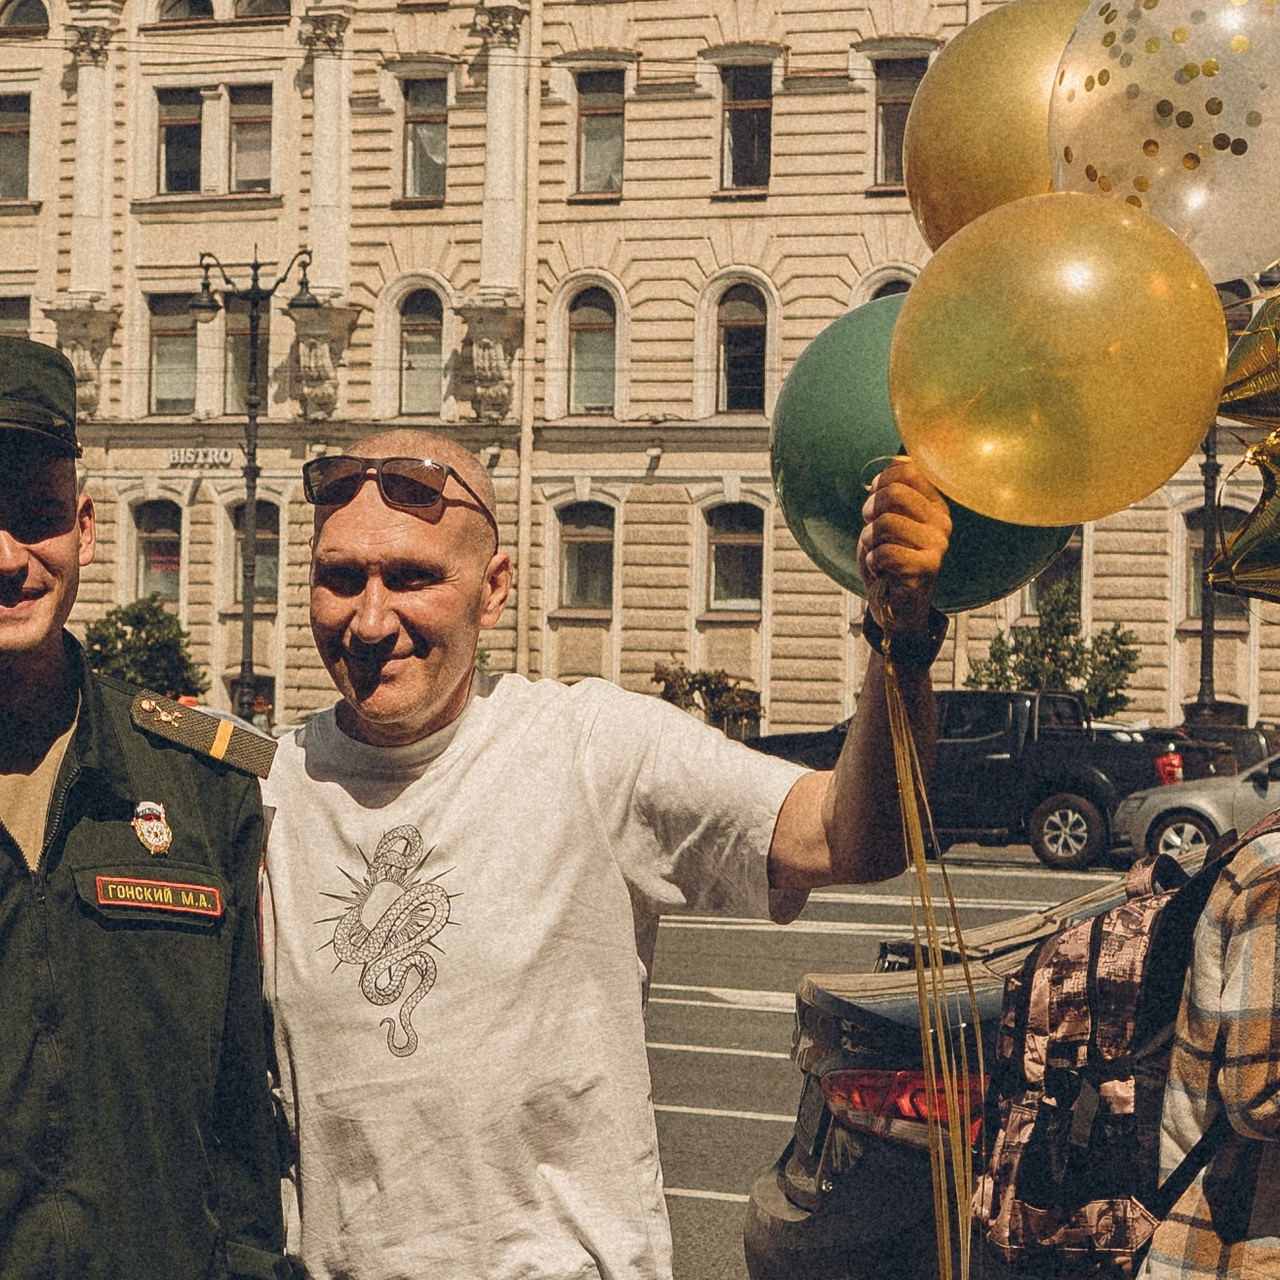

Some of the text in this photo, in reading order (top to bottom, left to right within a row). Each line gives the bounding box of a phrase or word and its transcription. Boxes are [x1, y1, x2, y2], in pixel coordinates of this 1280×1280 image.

[170, 447, 233, 468] BISTRO
[108, 884, 214, 909] ГОНСКИЙ М.А.
